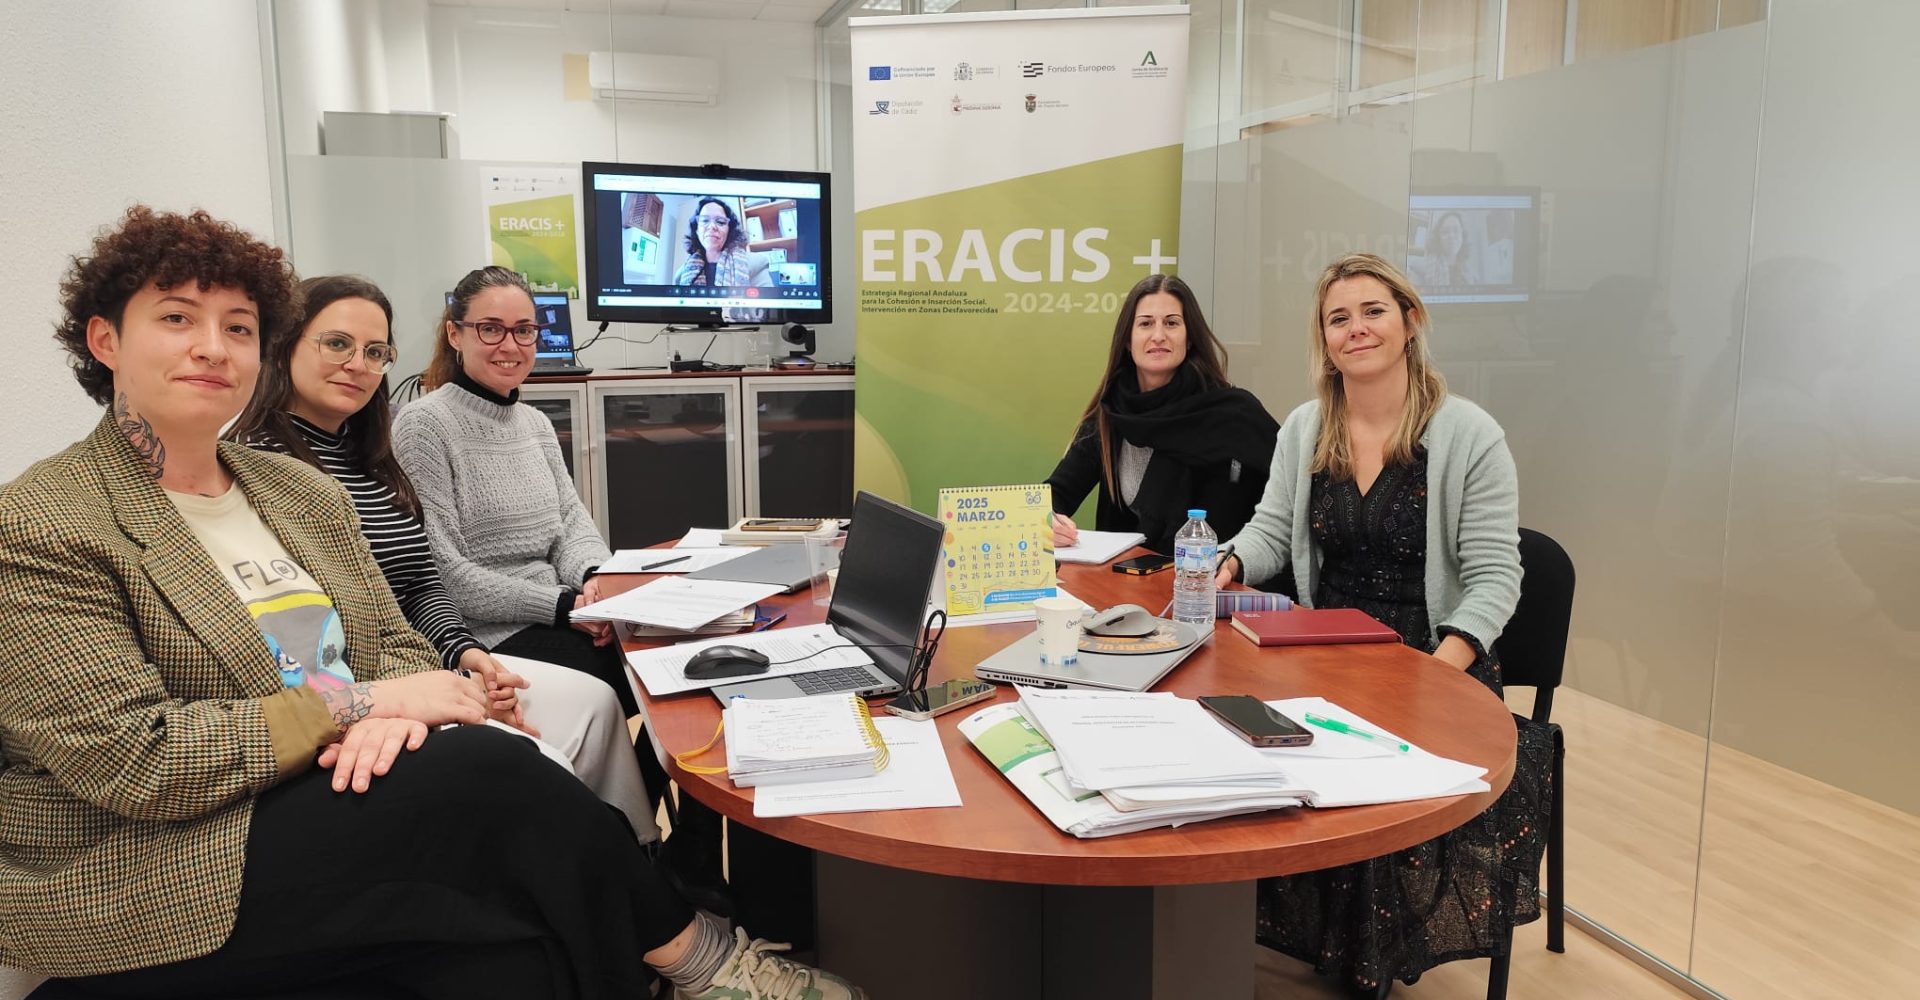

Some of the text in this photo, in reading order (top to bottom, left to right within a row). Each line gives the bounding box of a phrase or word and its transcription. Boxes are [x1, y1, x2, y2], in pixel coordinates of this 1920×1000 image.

[1047, 64, 1116, 73] Fondos Europeos
[500, 217, 564, 231] ERACIS +
[862, 227, 1177, 283] ERACIS +
[862, 290, 897, 298] Estrategia
[898, 290, 931, 298] Regional
[957, 497, 989, 509] 2025
[957, 510, 1005, 522] MARZO
[232, 559, 298, 591] FLO
